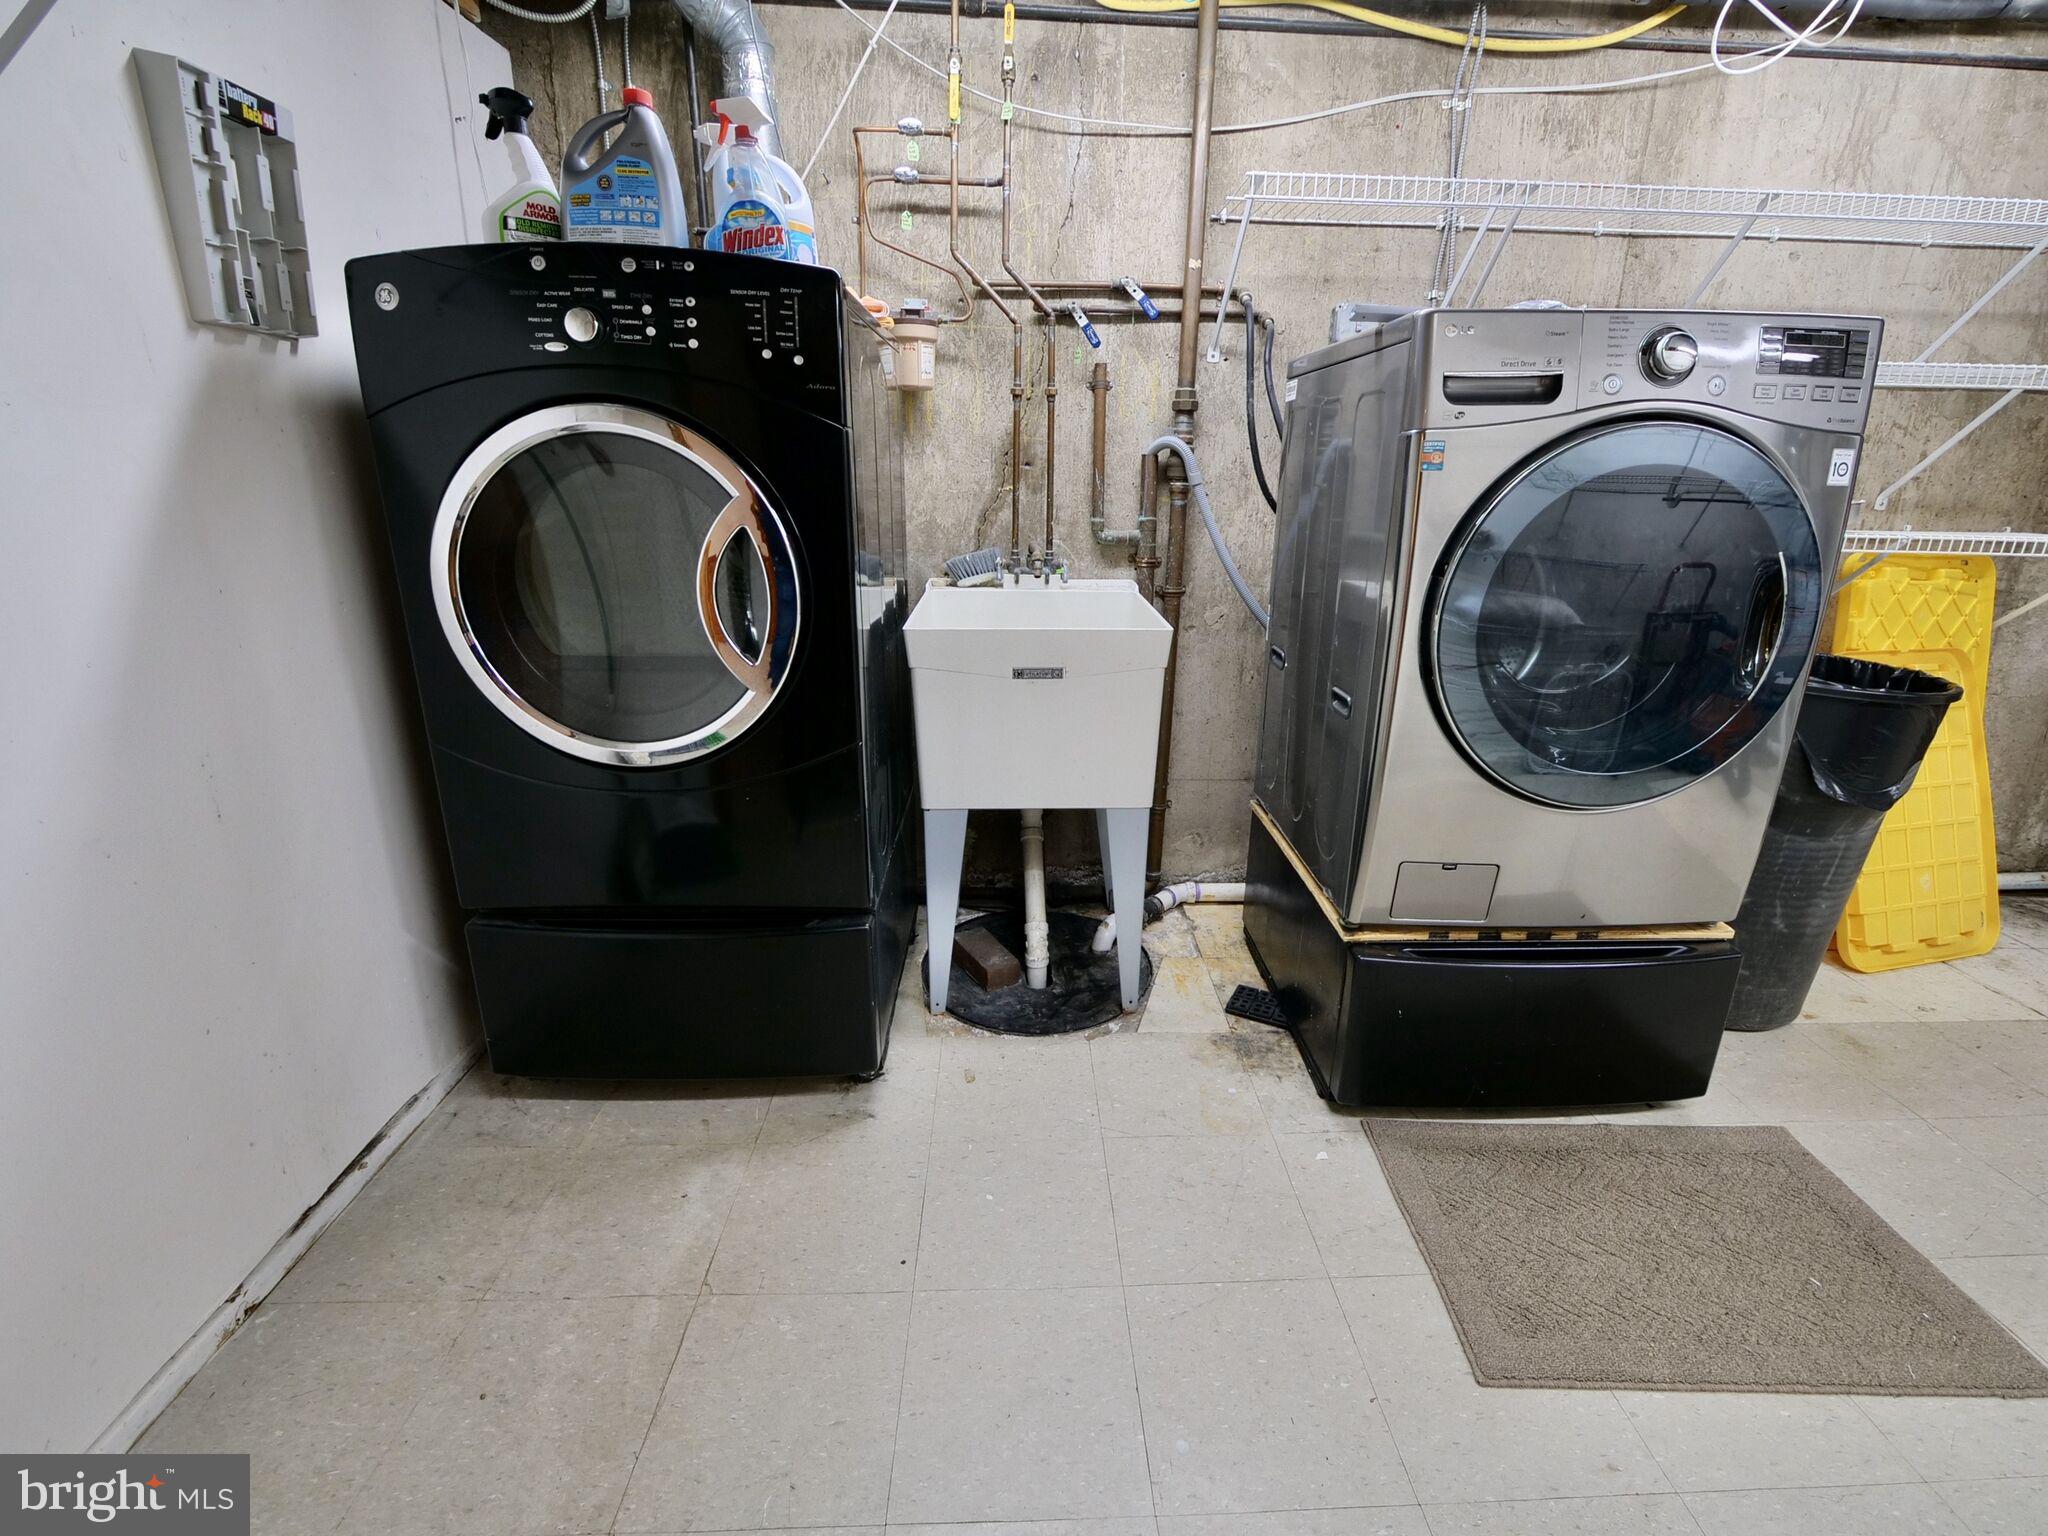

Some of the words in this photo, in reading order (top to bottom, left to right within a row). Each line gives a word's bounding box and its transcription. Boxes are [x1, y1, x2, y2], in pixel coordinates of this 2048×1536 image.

[226, 82, 258, 110] battery
[526, 201, 556, 214] MOLD
[522, 209, 560, 224] ARMOR
[722, 223, 785, 253] Windex
[1459, 325, 1475, 335] LG
[1501, 360, 1519, 368] Direct
[1520, 360, 1537, 368] Drive
